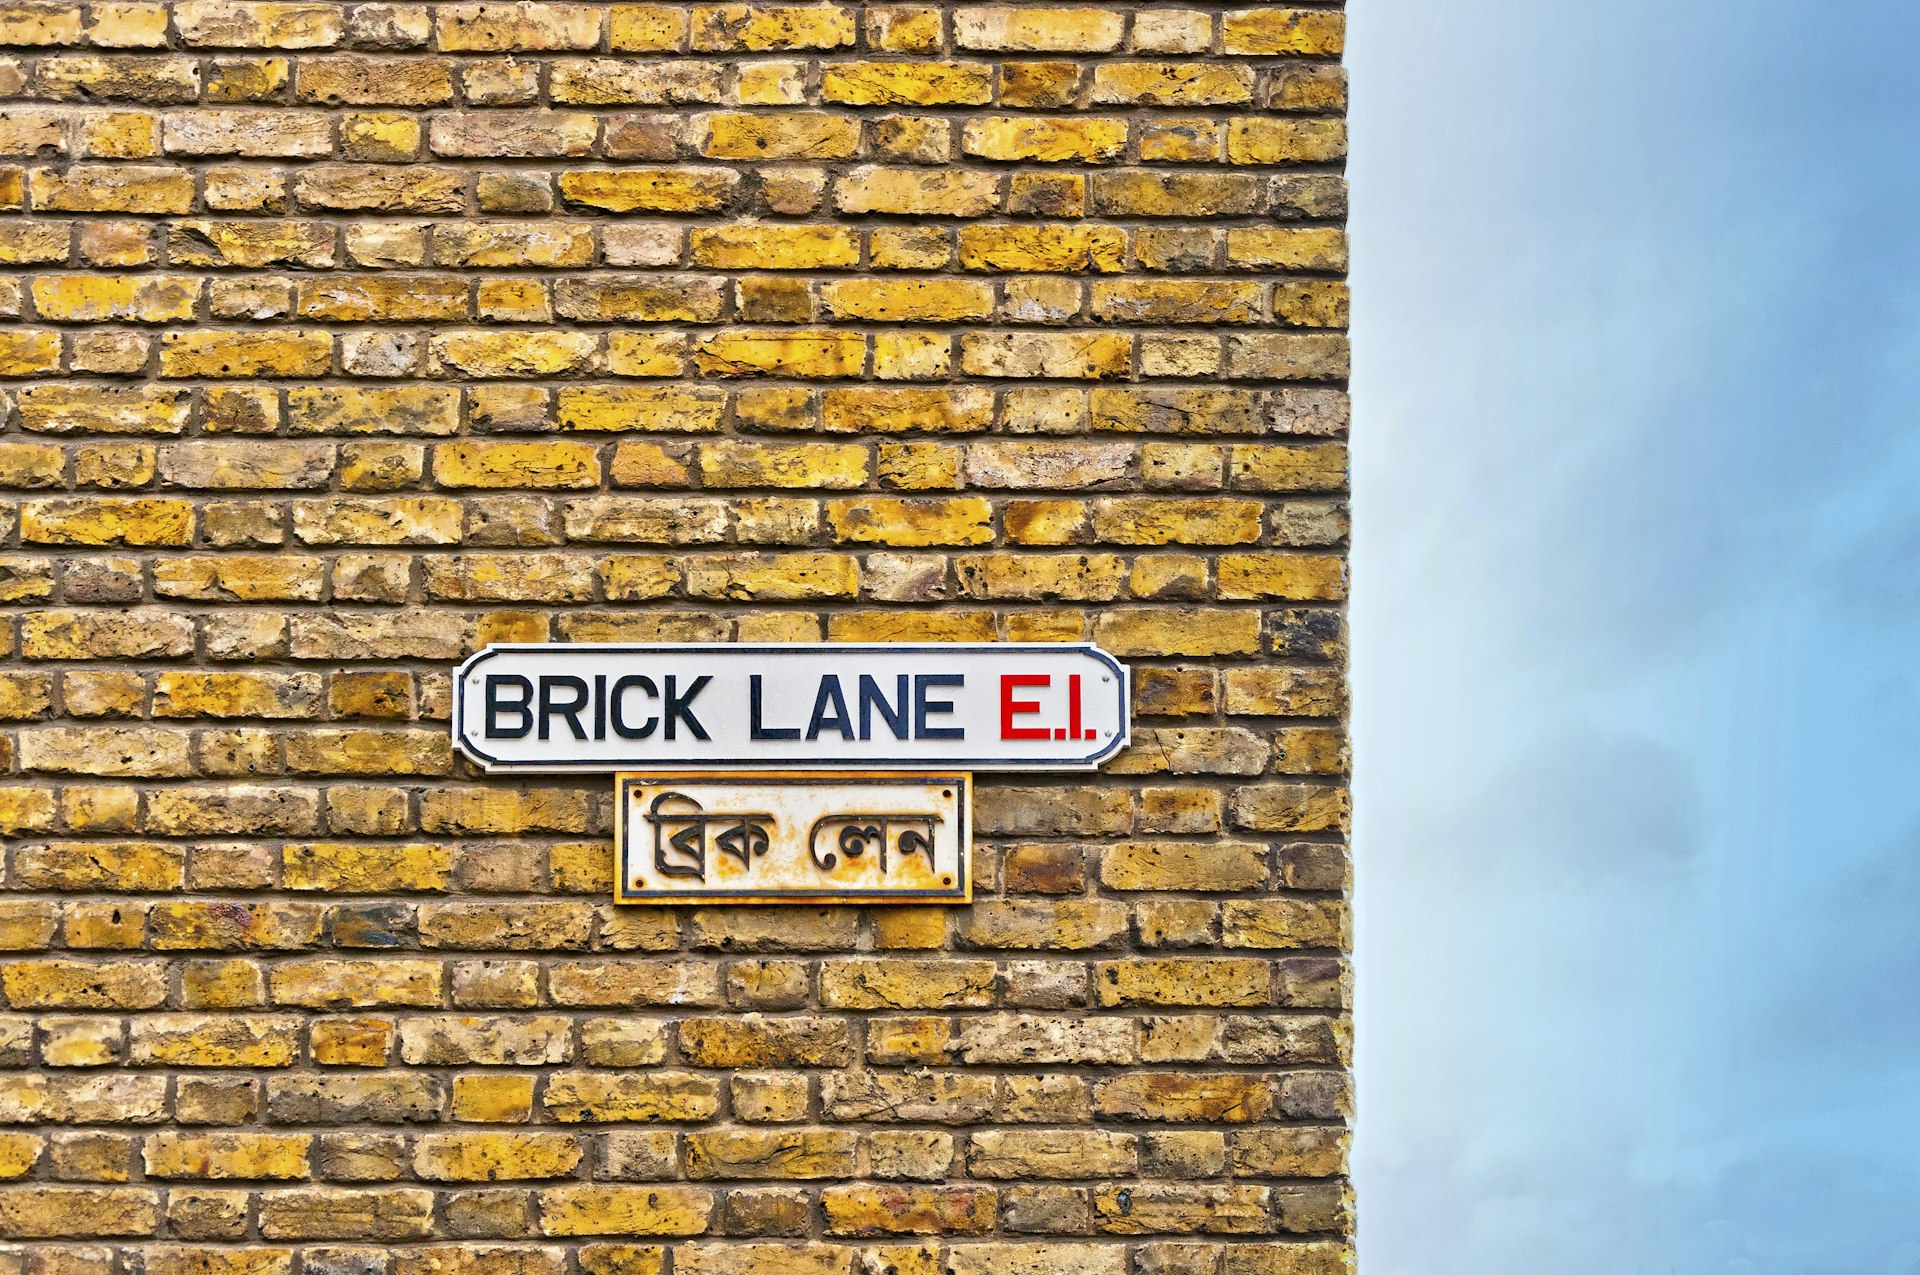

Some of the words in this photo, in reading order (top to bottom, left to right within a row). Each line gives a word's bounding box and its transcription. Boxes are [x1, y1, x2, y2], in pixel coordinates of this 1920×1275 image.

[485, 674, 714, 741] BRICK
[750, 674, 965, 741] LANE
[643, 791, 776, 884] ব্রিক
[809, 814, 944, 874] লেন
